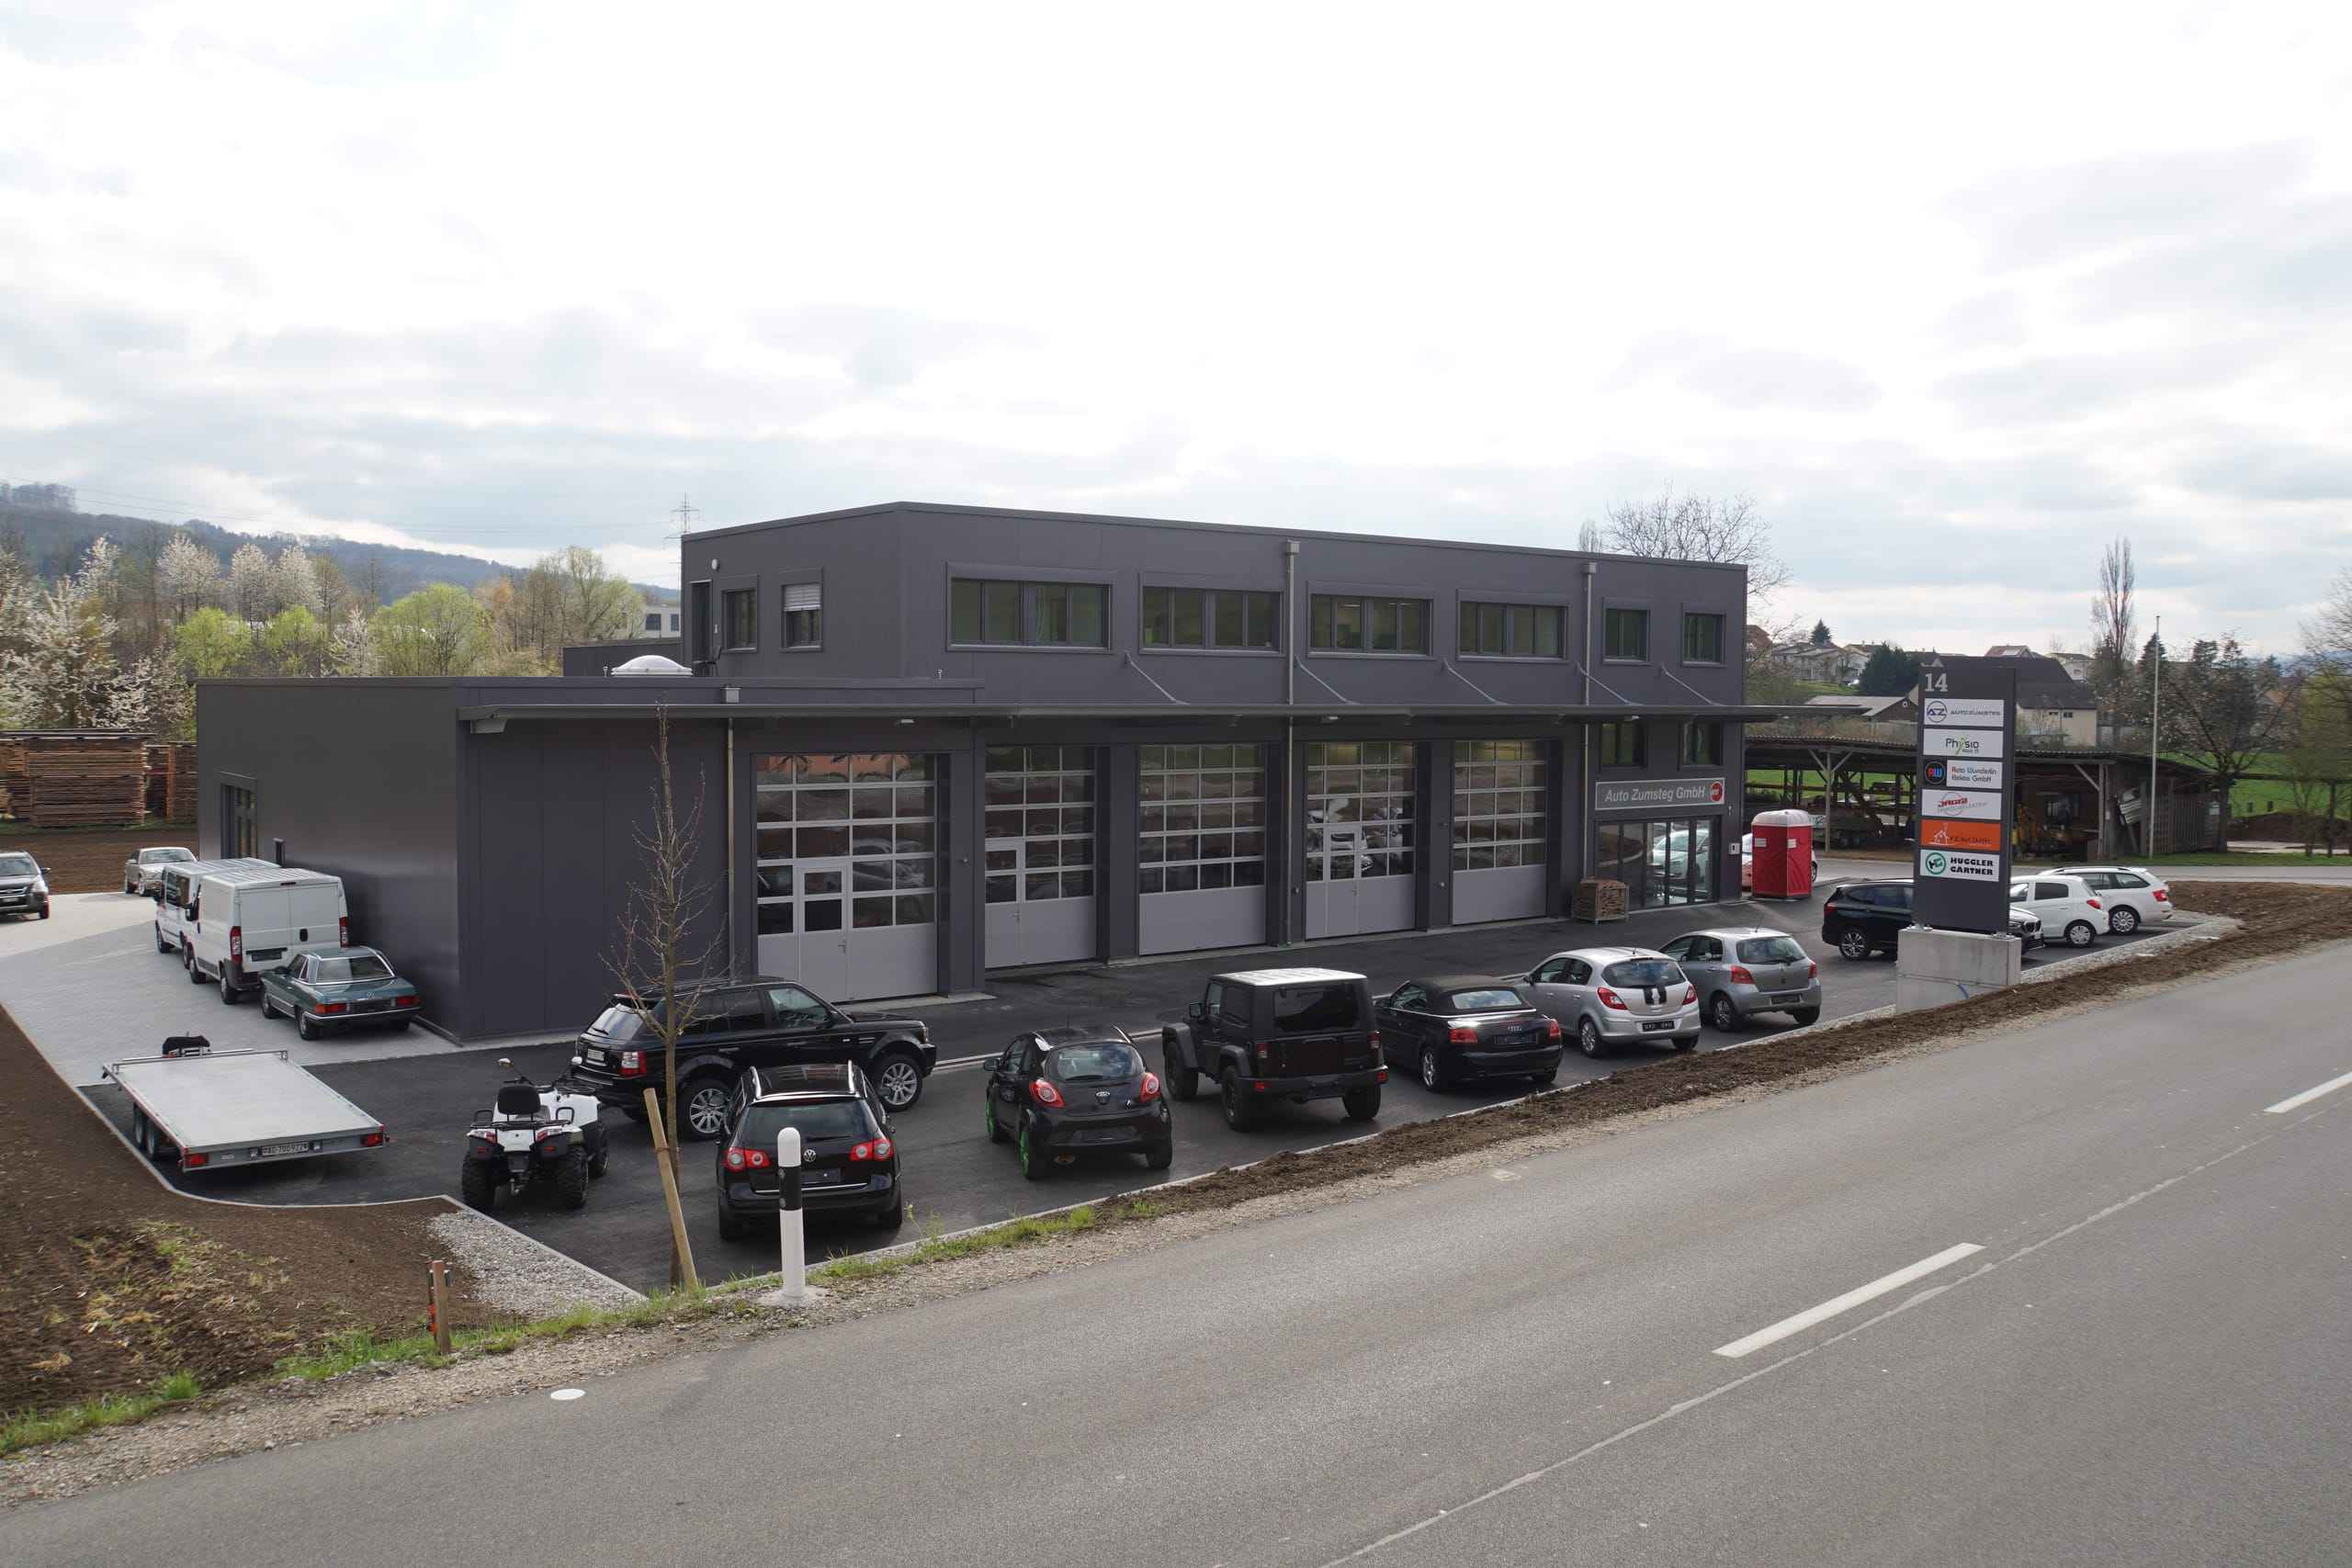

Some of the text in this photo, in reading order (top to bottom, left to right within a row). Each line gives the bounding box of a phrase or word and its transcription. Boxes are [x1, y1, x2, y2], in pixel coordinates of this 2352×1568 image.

[1925, 672, 1948, 692] 14
[1945, 738, 1980, 754] Physio
[1605, 790, 1629, 801] Auto
[1632, 788, 1673, 802] Zumsteg
[1676, 786, 1706, 799] GmbH
[1951, 857, 1993, 866] HUGGLER
